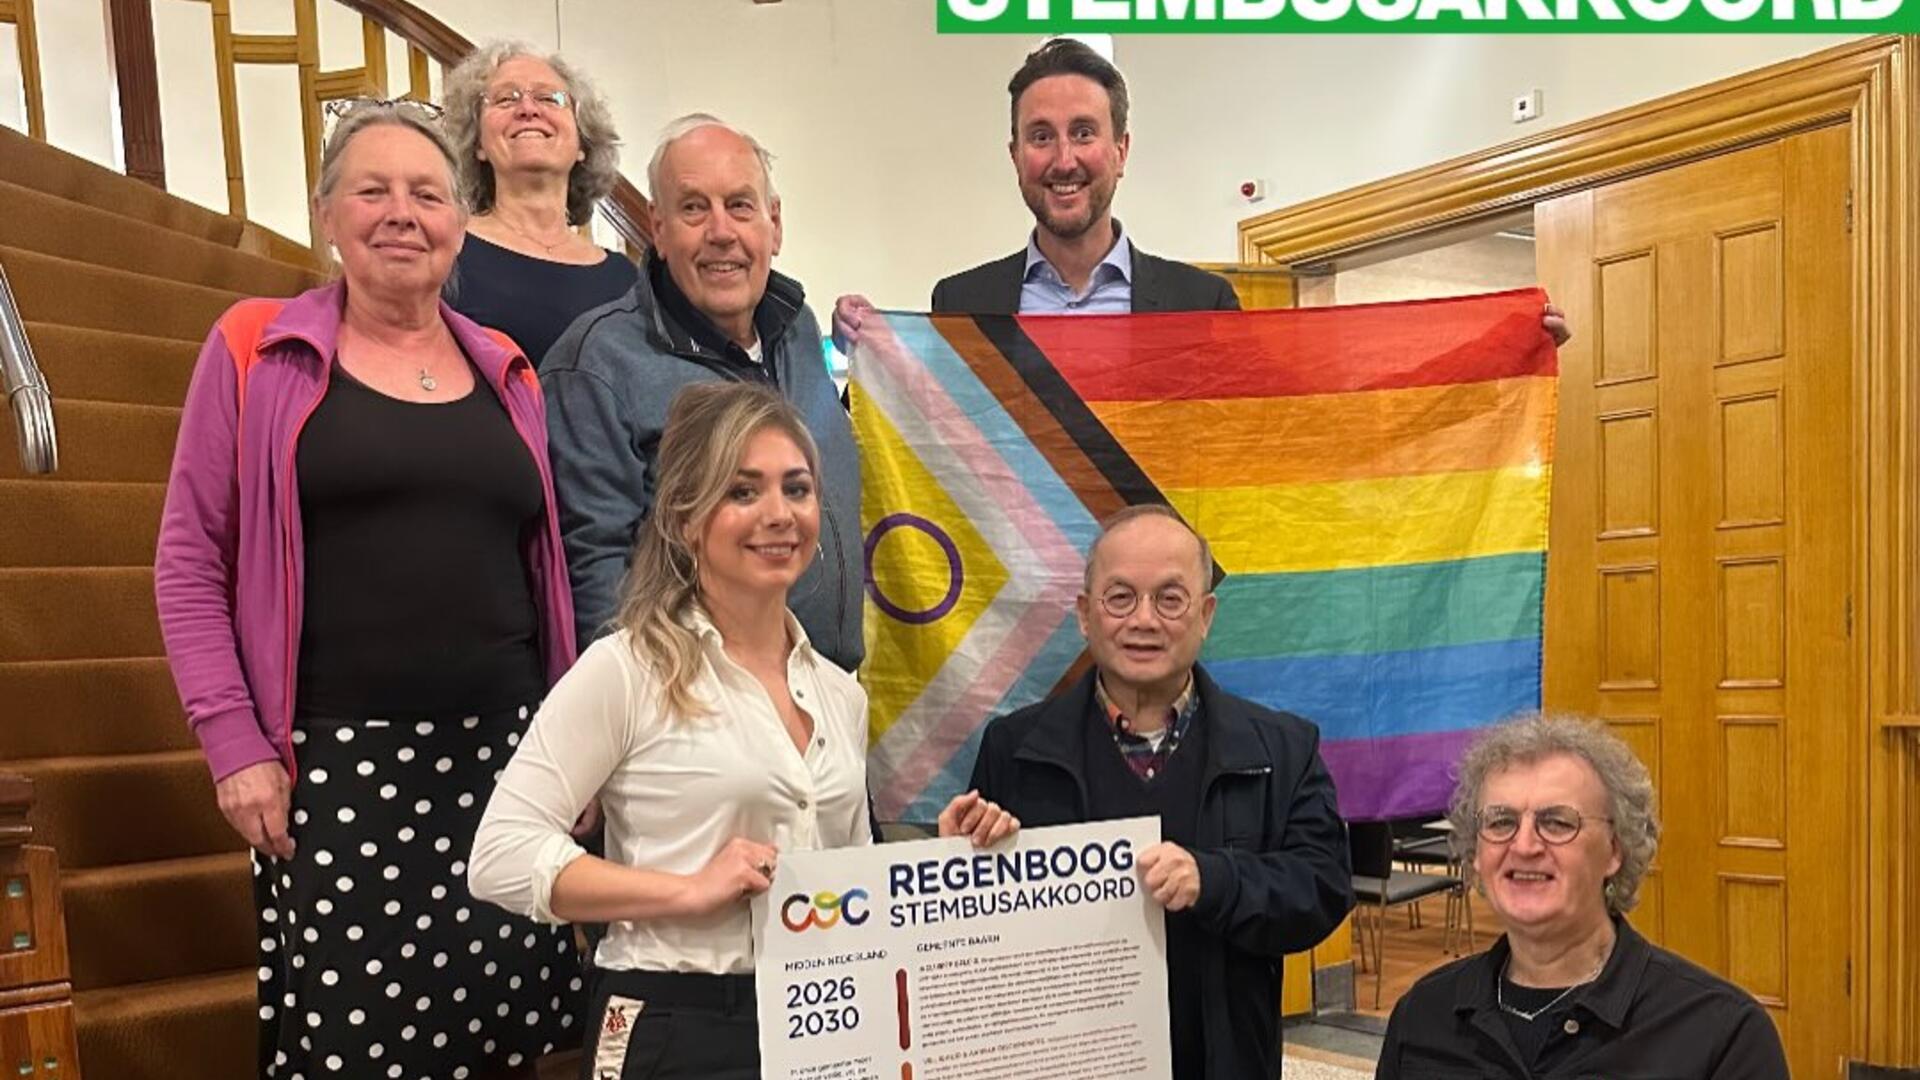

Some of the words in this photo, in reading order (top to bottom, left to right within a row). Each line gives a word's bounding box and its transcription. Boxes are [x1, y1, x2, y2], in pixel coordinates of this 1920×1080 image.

[890, 839, 1134, 898] REGENBOOG
[890, 876, 1136, 928] STEMBUSAKKOORD
[786, 976, 856, 1009] 2026
[788, 1006, 860, 1039] 2030
